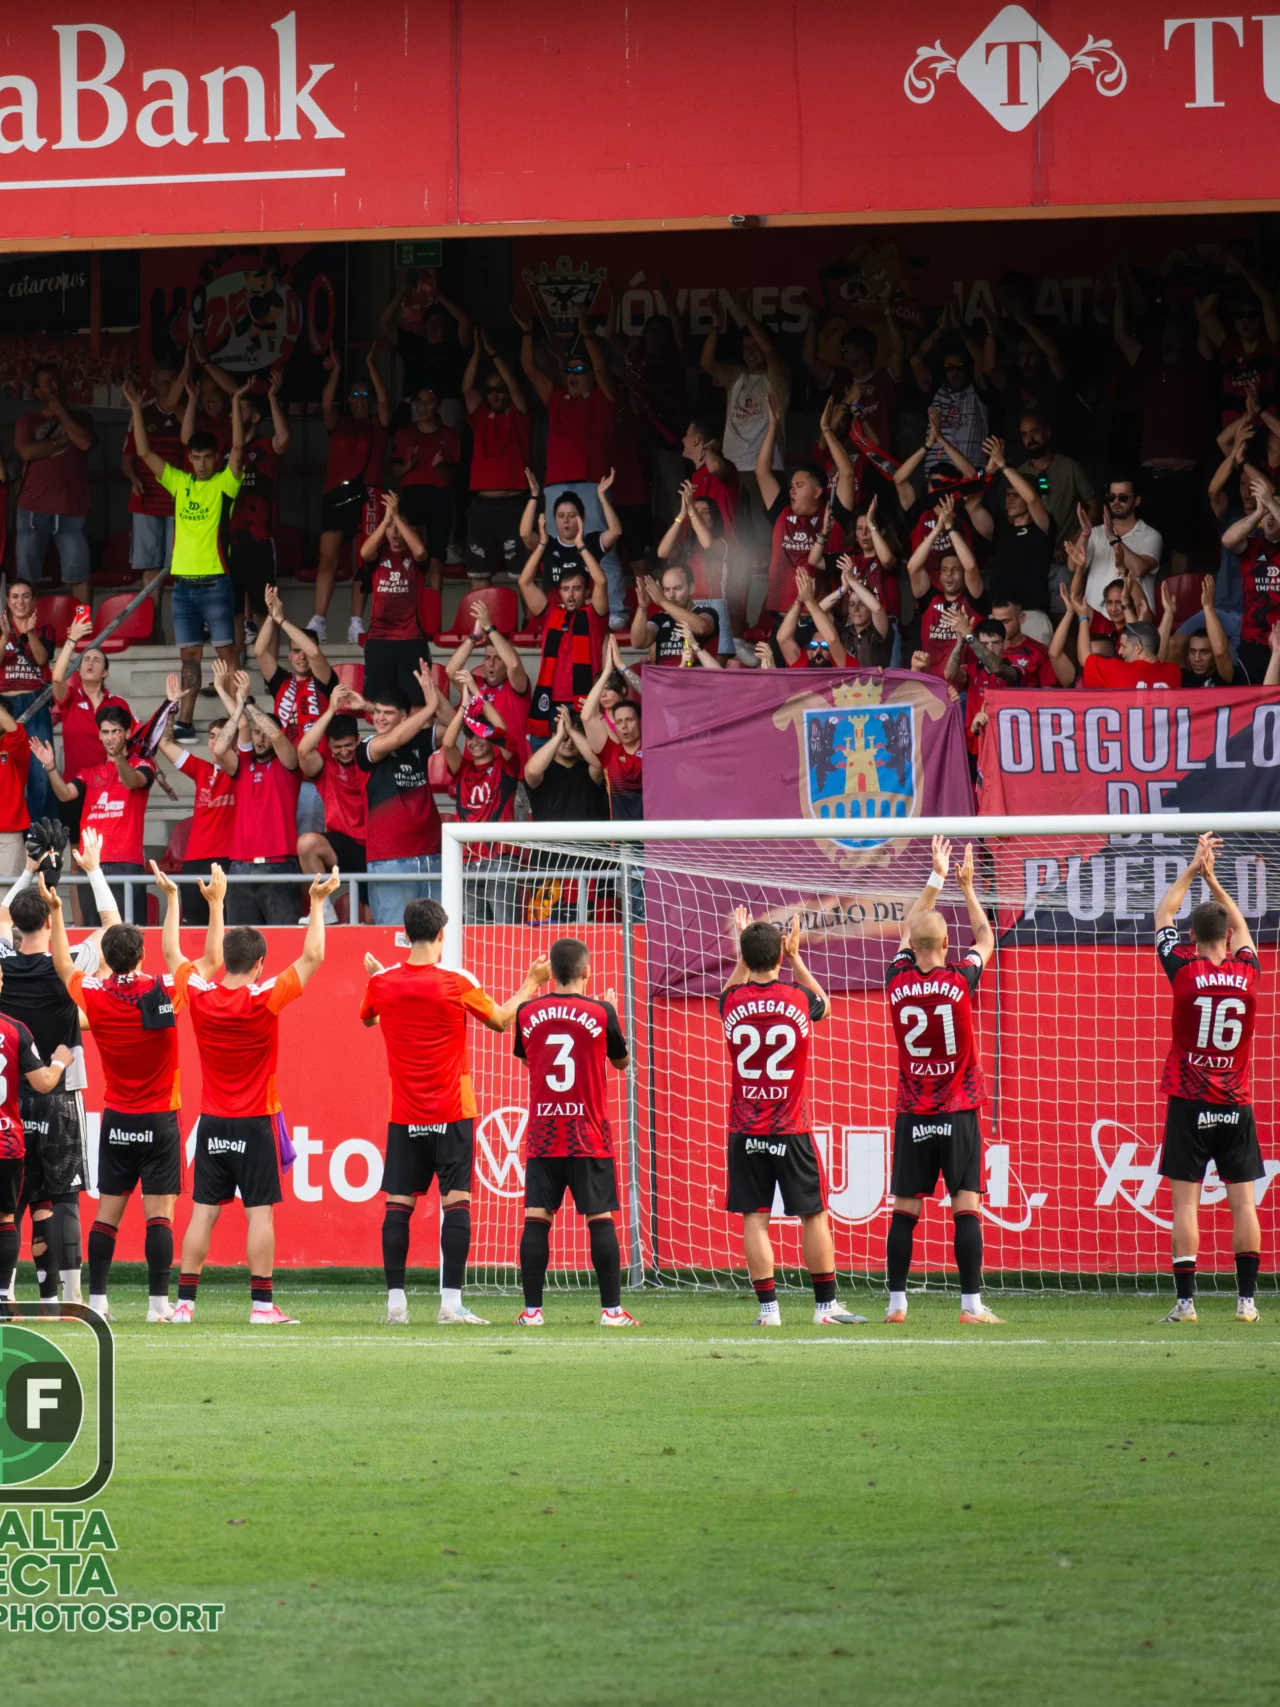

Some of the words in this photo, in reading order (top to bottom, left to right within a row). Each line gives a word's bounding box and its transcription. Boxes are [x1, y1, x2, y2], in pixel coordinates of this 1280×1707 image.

[8, 271, 88, 299] estaremos
[1255, 577, 1280, 585] MIRAN
[1256, 584, 1280, 592] EMPRE
[660, 648, 684, 656] EMPRES
[661, 642, 684, 650] MIRAN
[998, 703, 1280, 774] ORGULLO
[1106, 780, 1182, 847] DE
[1024, 855, 1269, 922] PUEBO
[871, 902, 905, 923] DE
[1195, 972, 1248, 992] MARKEL
[889, 981, 965, 1006] ARAMBARRI
[521, 1025, 532, 1039] H.
[528, 1006, 603, 1038] ARRILLAGA
[725, 1000, 810, 1041] AGUIRREGABIRIA
[899, 1003, 957, 1057] 21
[1192, 995, 1247, 1051] 16
[731, 1024, 796, 1080] 22
[1187, 1053, 1235, 1069] IZADI
[544, 1033, 576, 1093] 3
[910, 1060, 957, 1076] IZADI
[741, 1085, 789, 1100] IZADI
[536, 1102, 585, 1117] IZADI
[1198, 1111, 1241, 1126] Alucoil
[21, 1119, 49, 1135] lucoil
[108, 1127, 154, 1144] Alucoil
[911, 1123, 953, 1140] Alucoil
[207, 1136, 247, 1154] Alucoil
